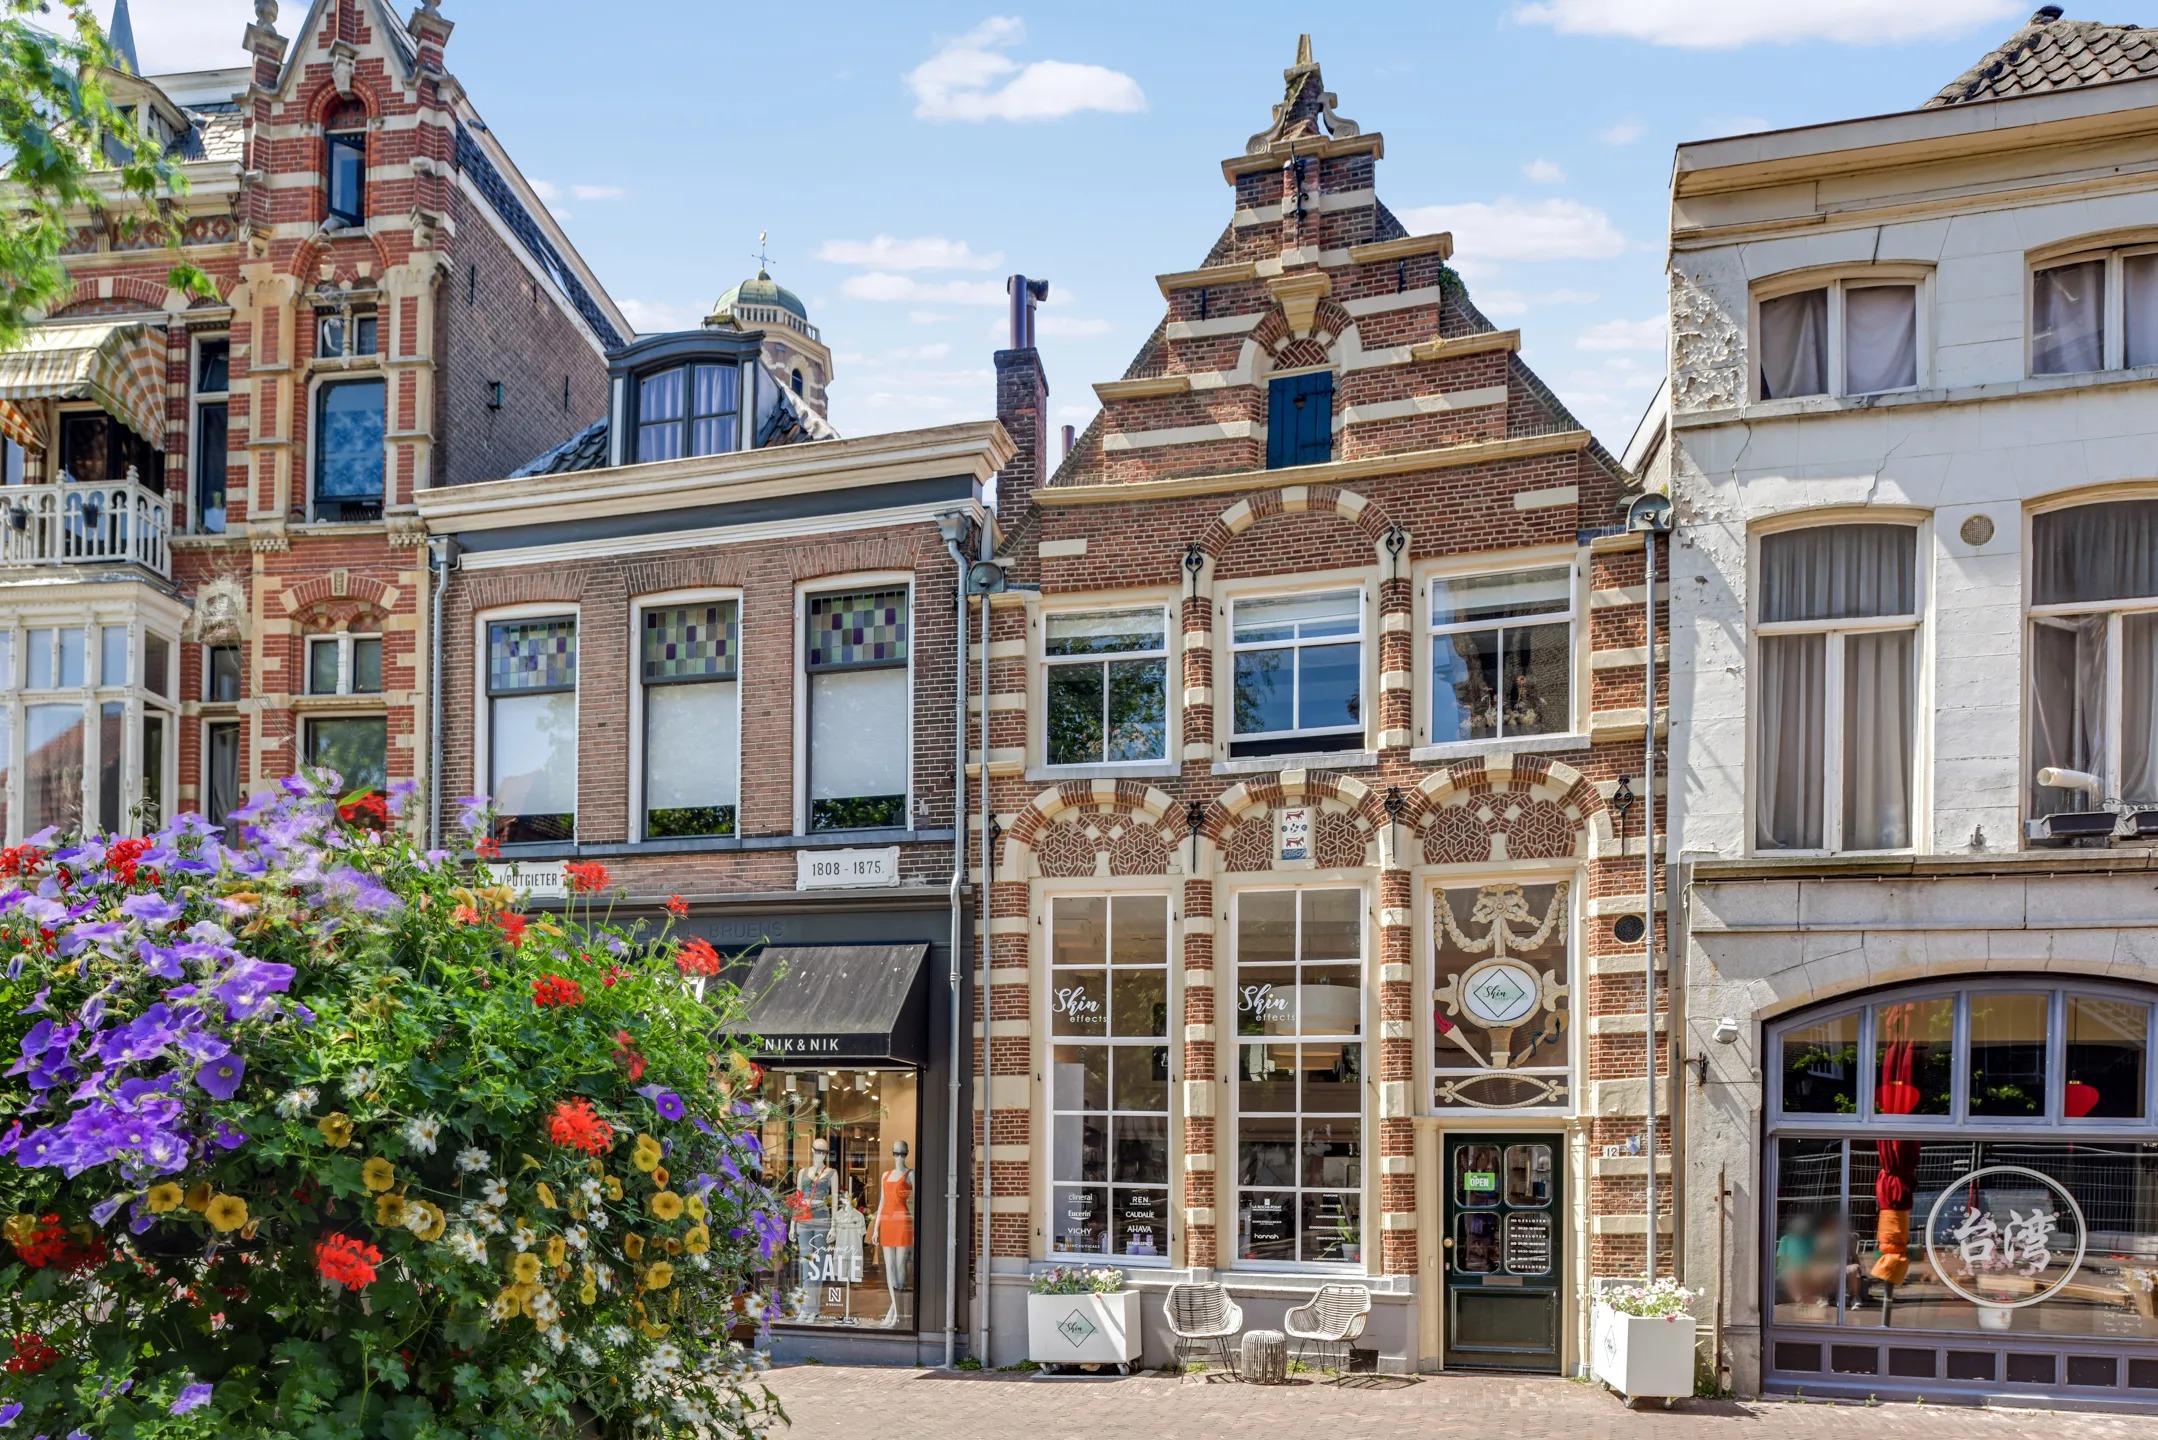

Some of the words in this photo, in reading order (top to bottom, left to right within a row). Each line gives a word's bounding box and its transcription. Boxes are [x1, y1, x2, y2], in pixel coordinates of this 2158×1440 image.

[812, 862, 840, 876] 1808
[708, 921, 784, 940] BRUENS
[1483, 985, 1506, 999] Skin
[1052, 986, 1100, 1016] Skin
[1238, 984, 1289, 1015] Skin
[1069, 1014, 1107, 1023] effects
[1255, 1013, 1296, 1022] effects
[1606, 1147, 1618, 1157] 12
[1470, 1178, 1489, 1187] OPEN
[1067, 1227, 1092, 1235] VICHY
[1126, 1225, 1153, 1233] AHAVA
[808, 1233, 859, 1257] Summer
[1953, 1206, 2057, 1272] 台湾
[807, 1253, 863, 1283] SALE
